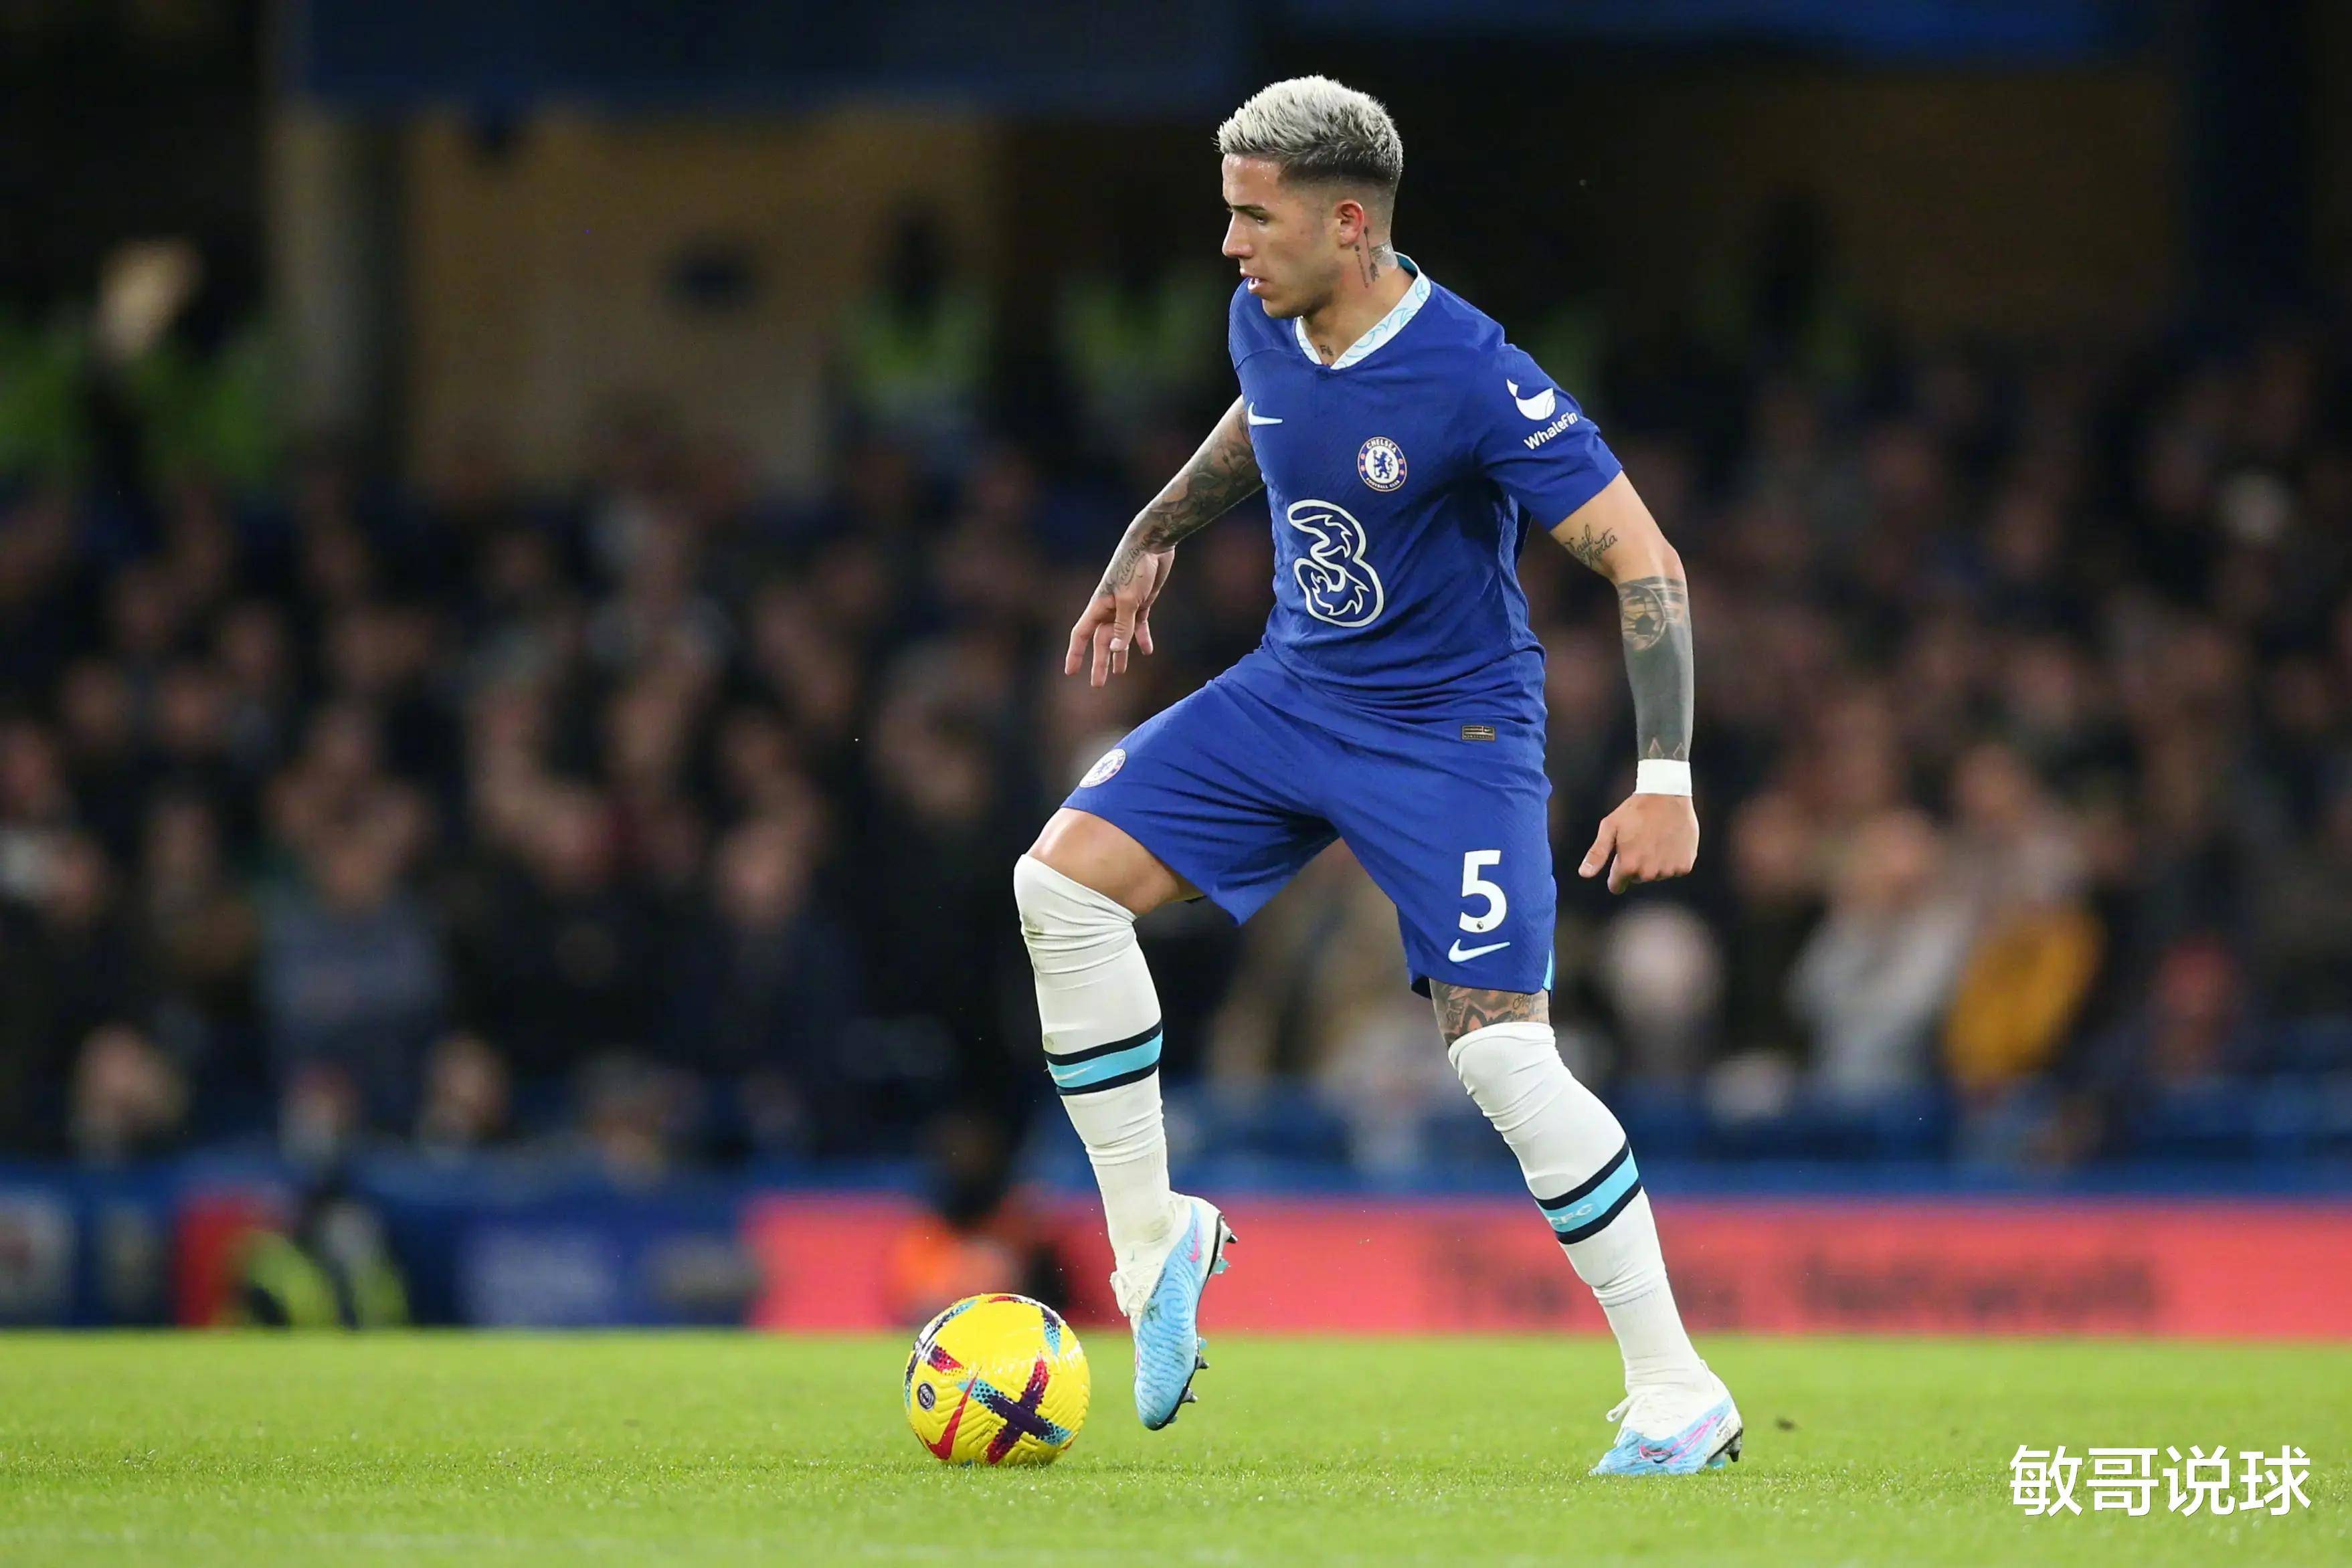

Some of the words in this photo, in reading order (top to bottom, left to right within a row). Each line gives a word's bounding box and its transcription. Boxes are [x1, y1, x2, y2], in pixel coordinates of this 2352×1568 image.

[1366, 438, 1396, 454] CHELSEA
[1523, 411, 1578, 450] WhaleFin
[1459, 850, 1507, 933] 5
